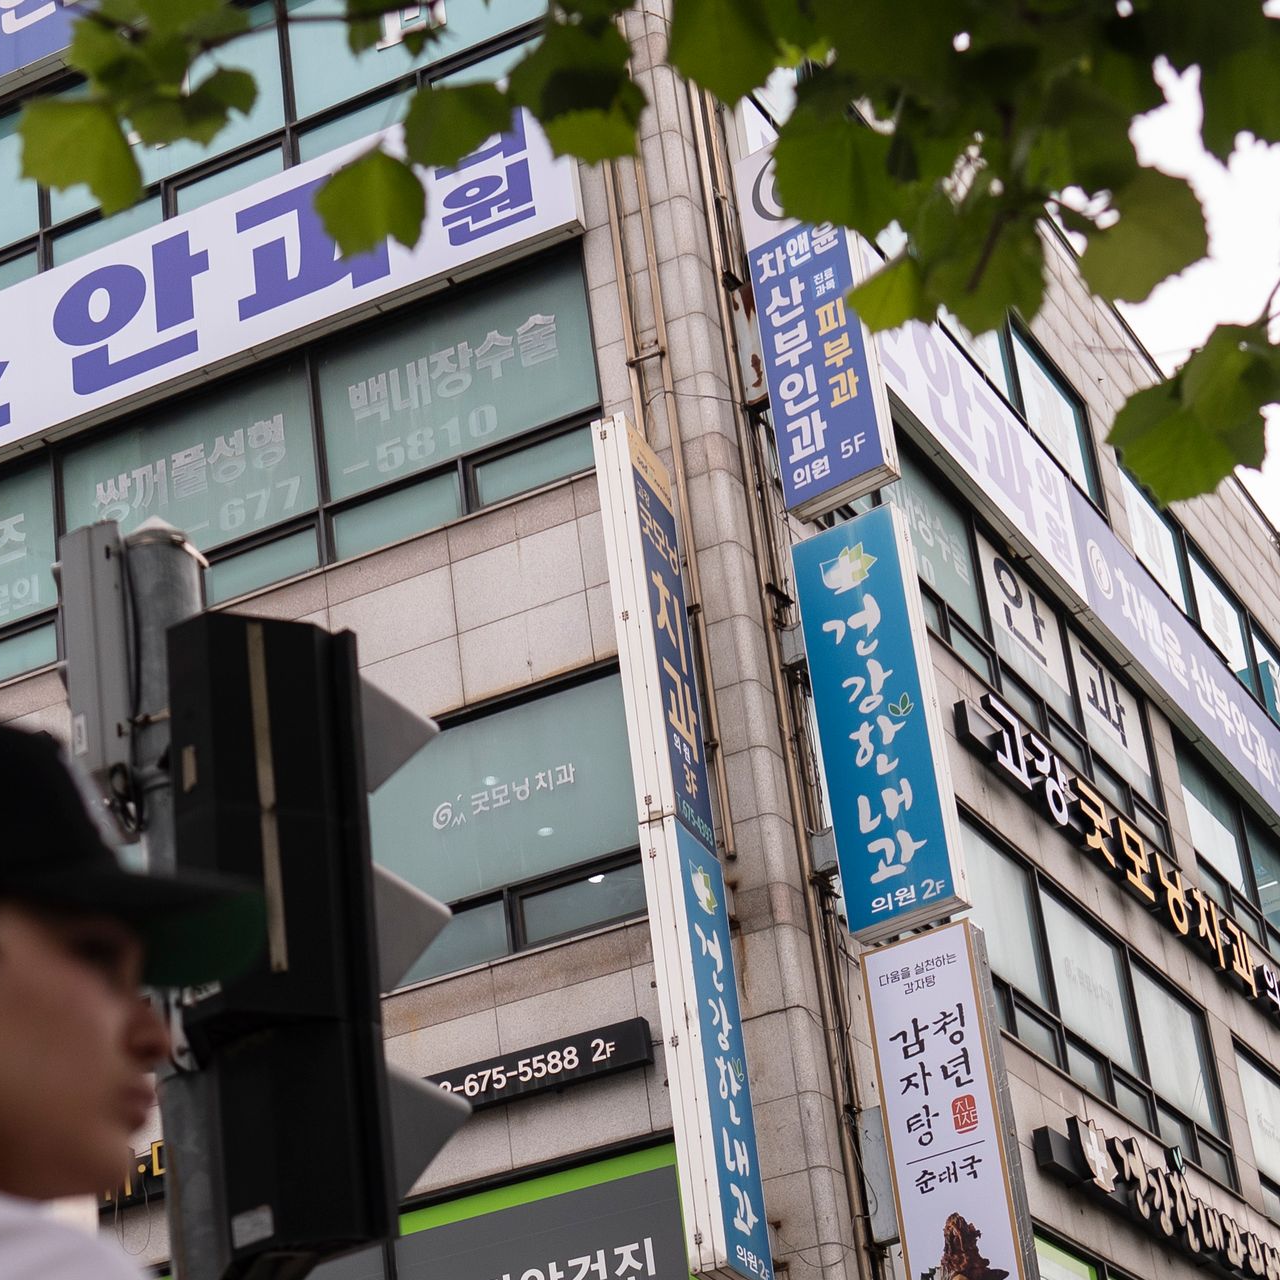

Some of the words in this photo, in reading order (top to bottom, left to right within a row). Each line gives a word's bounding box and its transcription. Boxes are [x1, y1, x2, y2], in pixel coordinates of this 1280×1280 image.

[347, 313, 559, 424] 백내장수술
[815, 296, 860, 409] 피부과
[840, 432, 867, 459] 5F
[793, 455, 830, 490] 의원
[870, 885, 918, 915] 의원
[921, 878, 946, 901] 2F
[914, 952, 957, 975] 실천하는
[903, 974, 937, 995] 감자탕
[590, 1038, 617, 1063] 2F
[914, 1155, 983, 1195] 순대국
